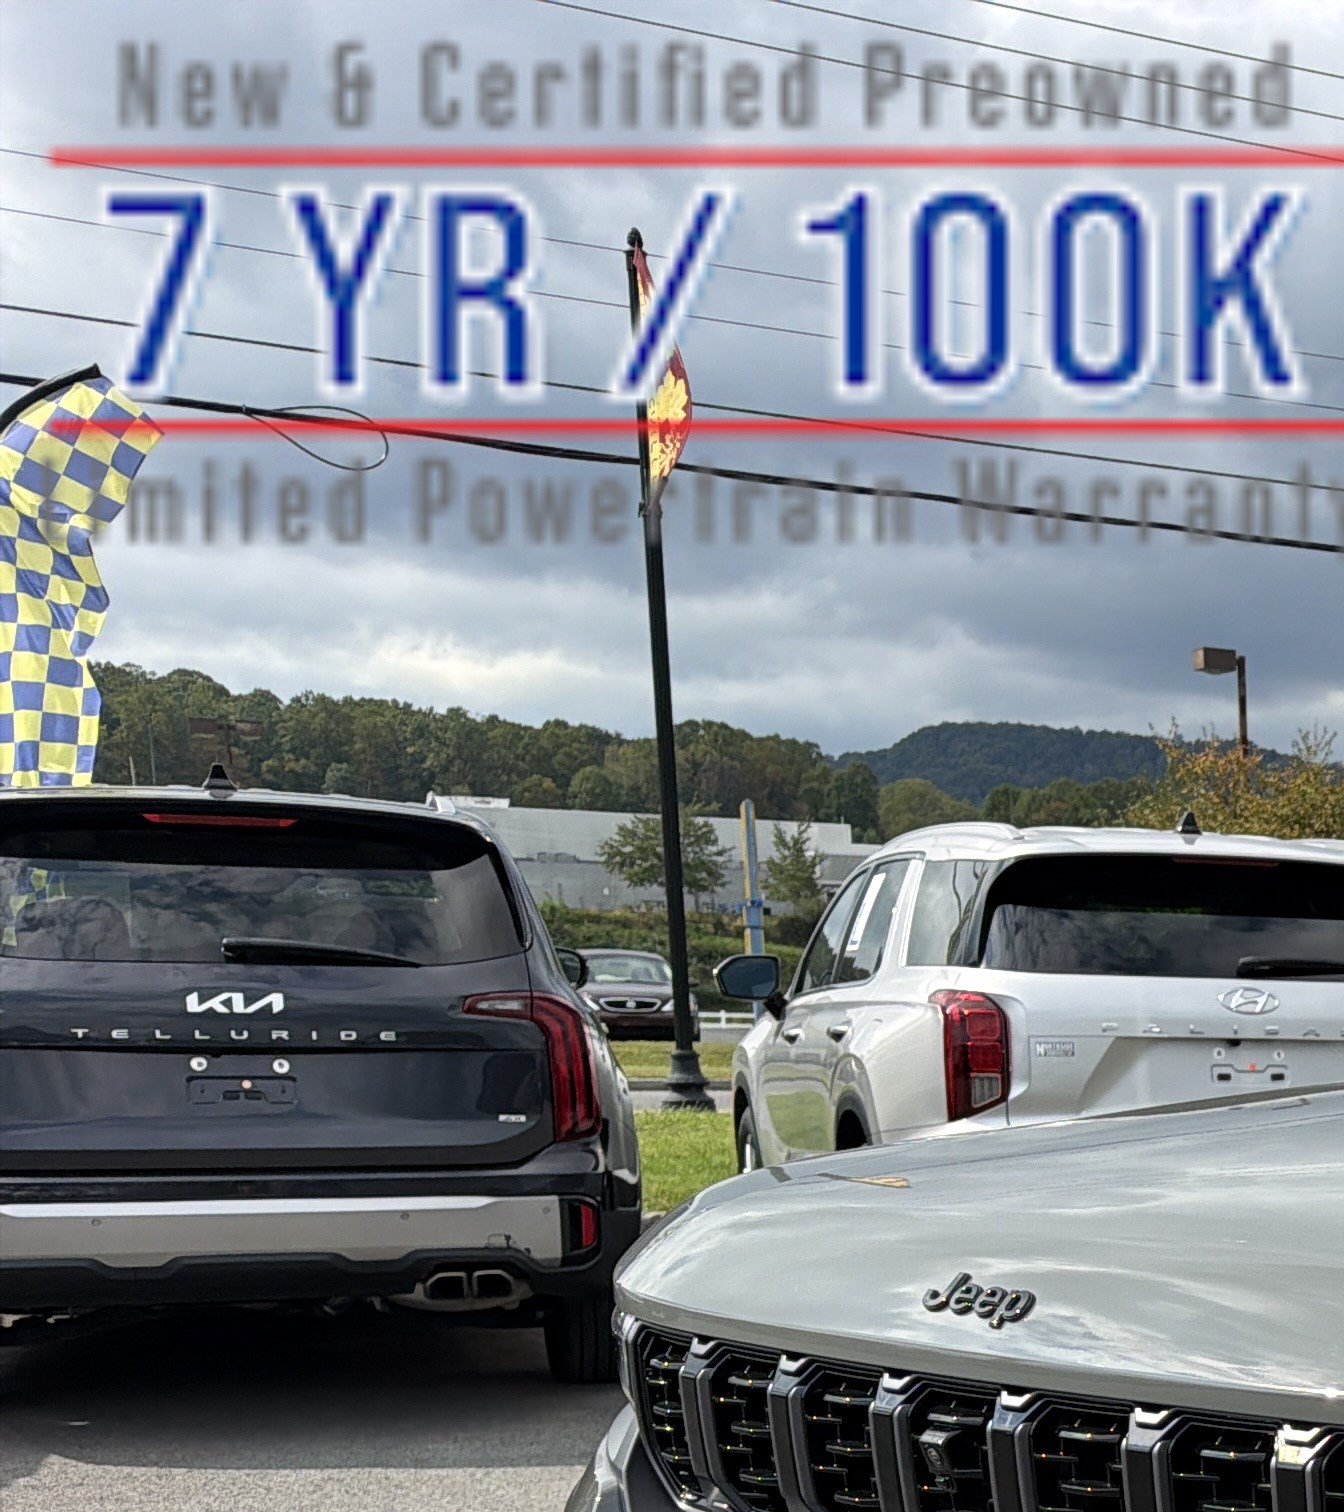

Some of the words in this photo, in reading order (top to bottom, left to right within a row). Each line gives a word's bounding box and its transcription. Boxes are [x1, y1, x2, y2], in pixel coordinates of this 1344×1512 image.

[186, 991, 284, 1014] KIA
[71, 1028, 397, 1041] TELLURIDE
[922, 1272, 1037, 1330] Jeep
